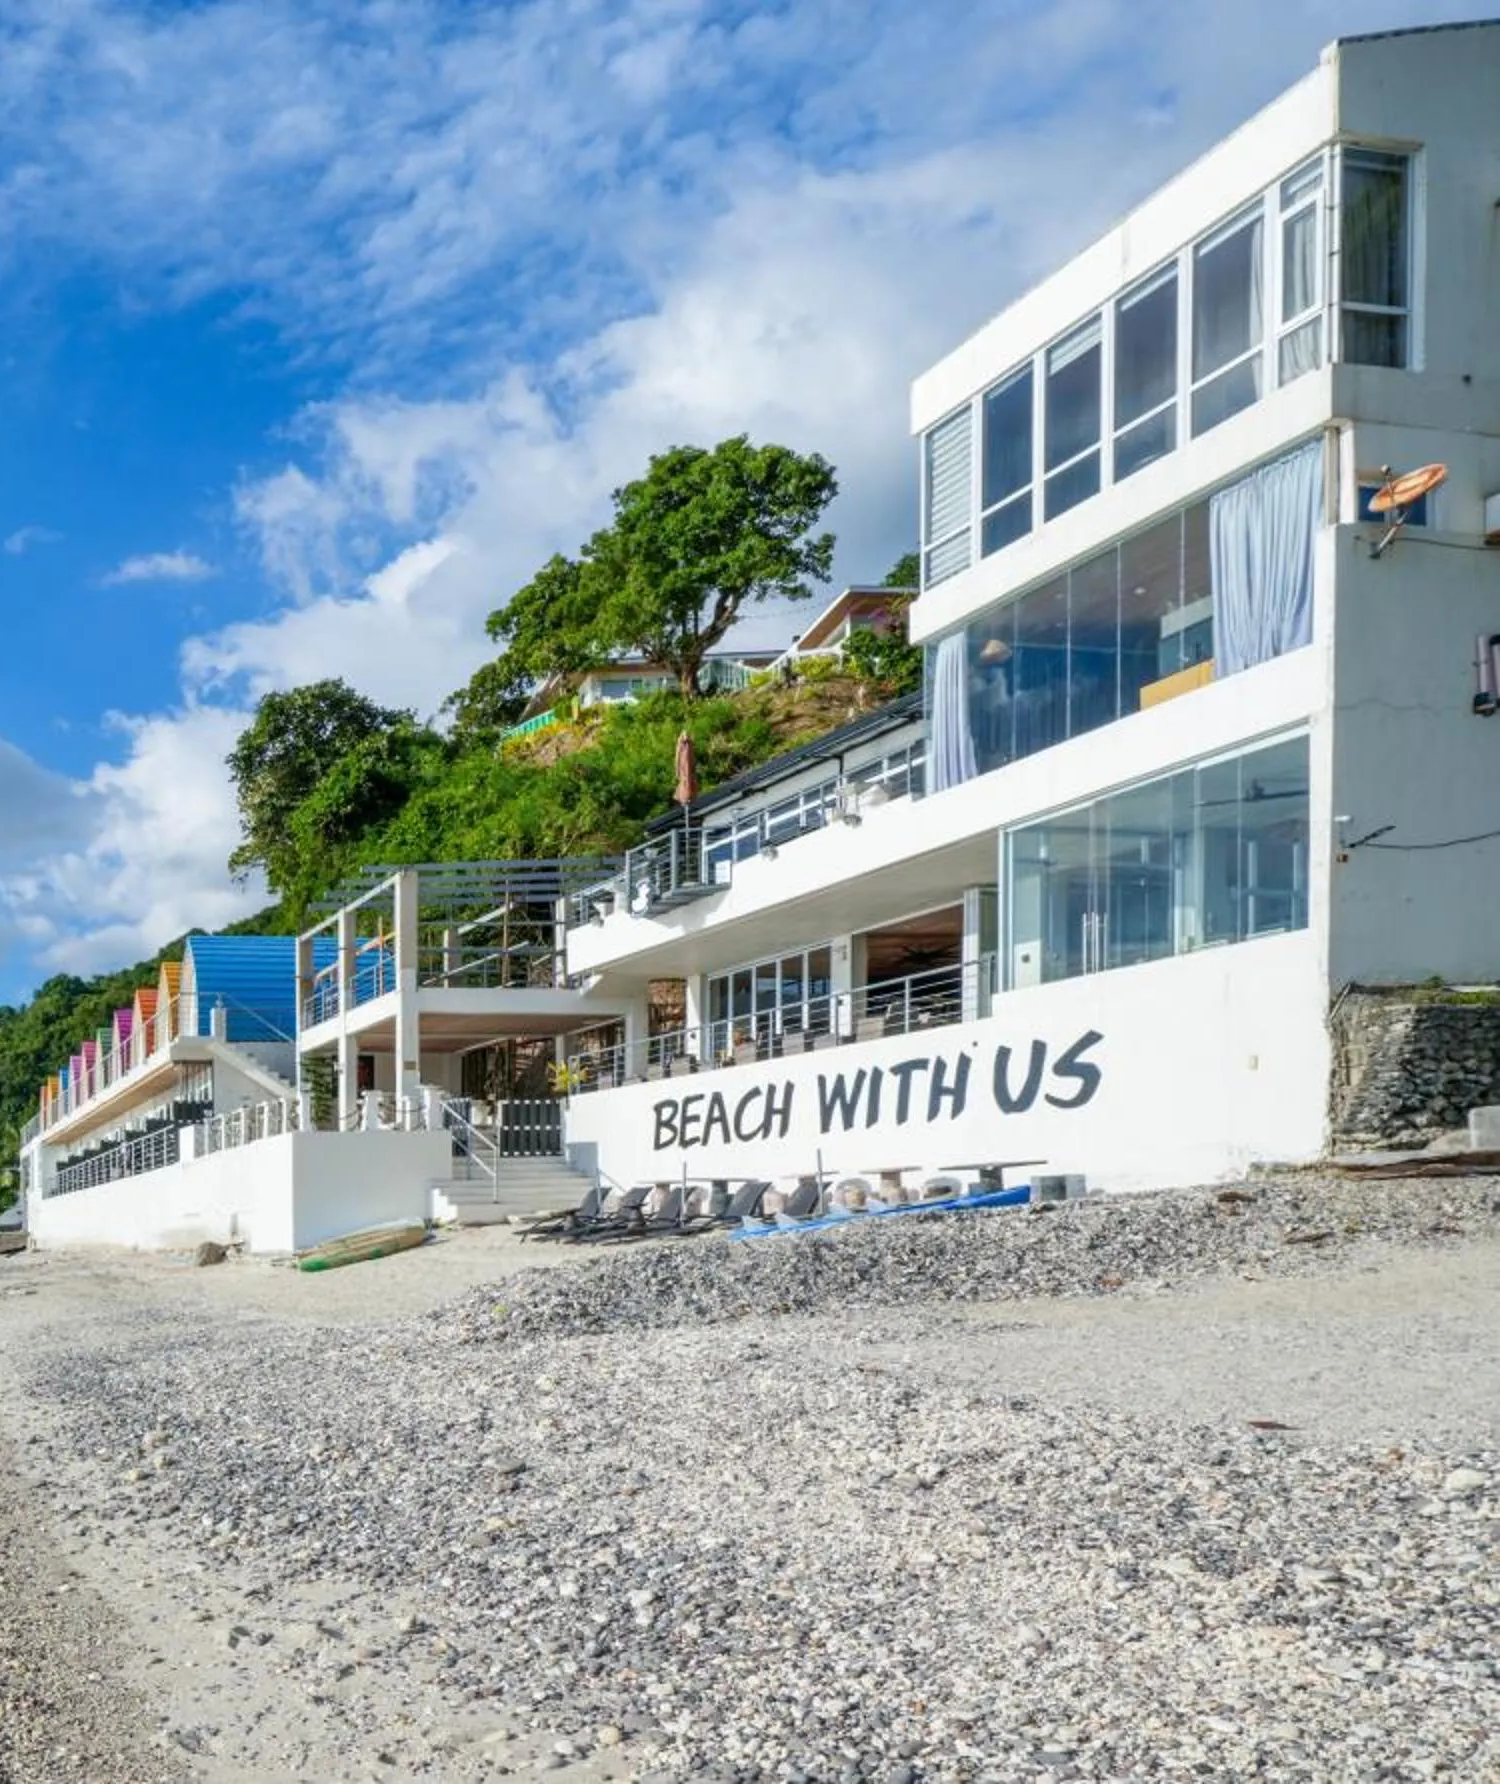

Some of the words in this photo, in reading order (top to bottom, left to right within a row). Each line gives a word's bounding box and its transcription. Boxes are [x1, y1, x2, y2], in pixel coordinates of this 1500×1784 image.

[653, 1081, 794, 1150] BEACH
[817, 1053, 971, 1133] WITH
[993, 1030, 1103, 1114] US
